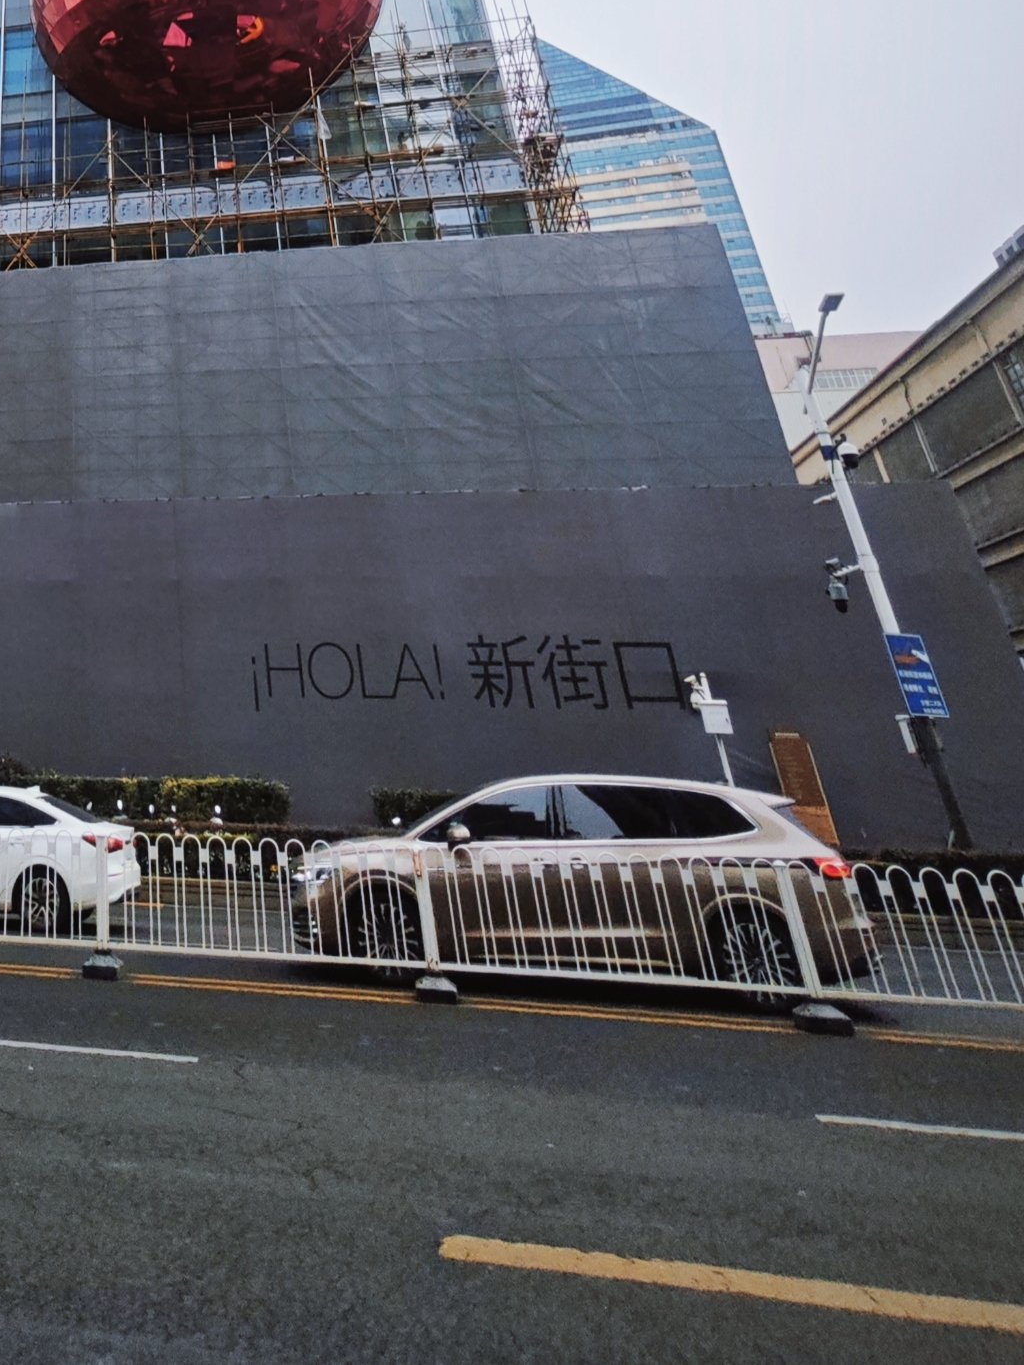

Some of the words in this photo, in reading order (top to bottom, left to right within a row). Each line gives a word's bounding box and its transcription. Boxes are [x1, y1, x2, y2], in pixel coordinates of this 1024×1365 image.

[251, 641, 446, 712] ¡HOLA!
[466, 634, 687, 711] 新街口
